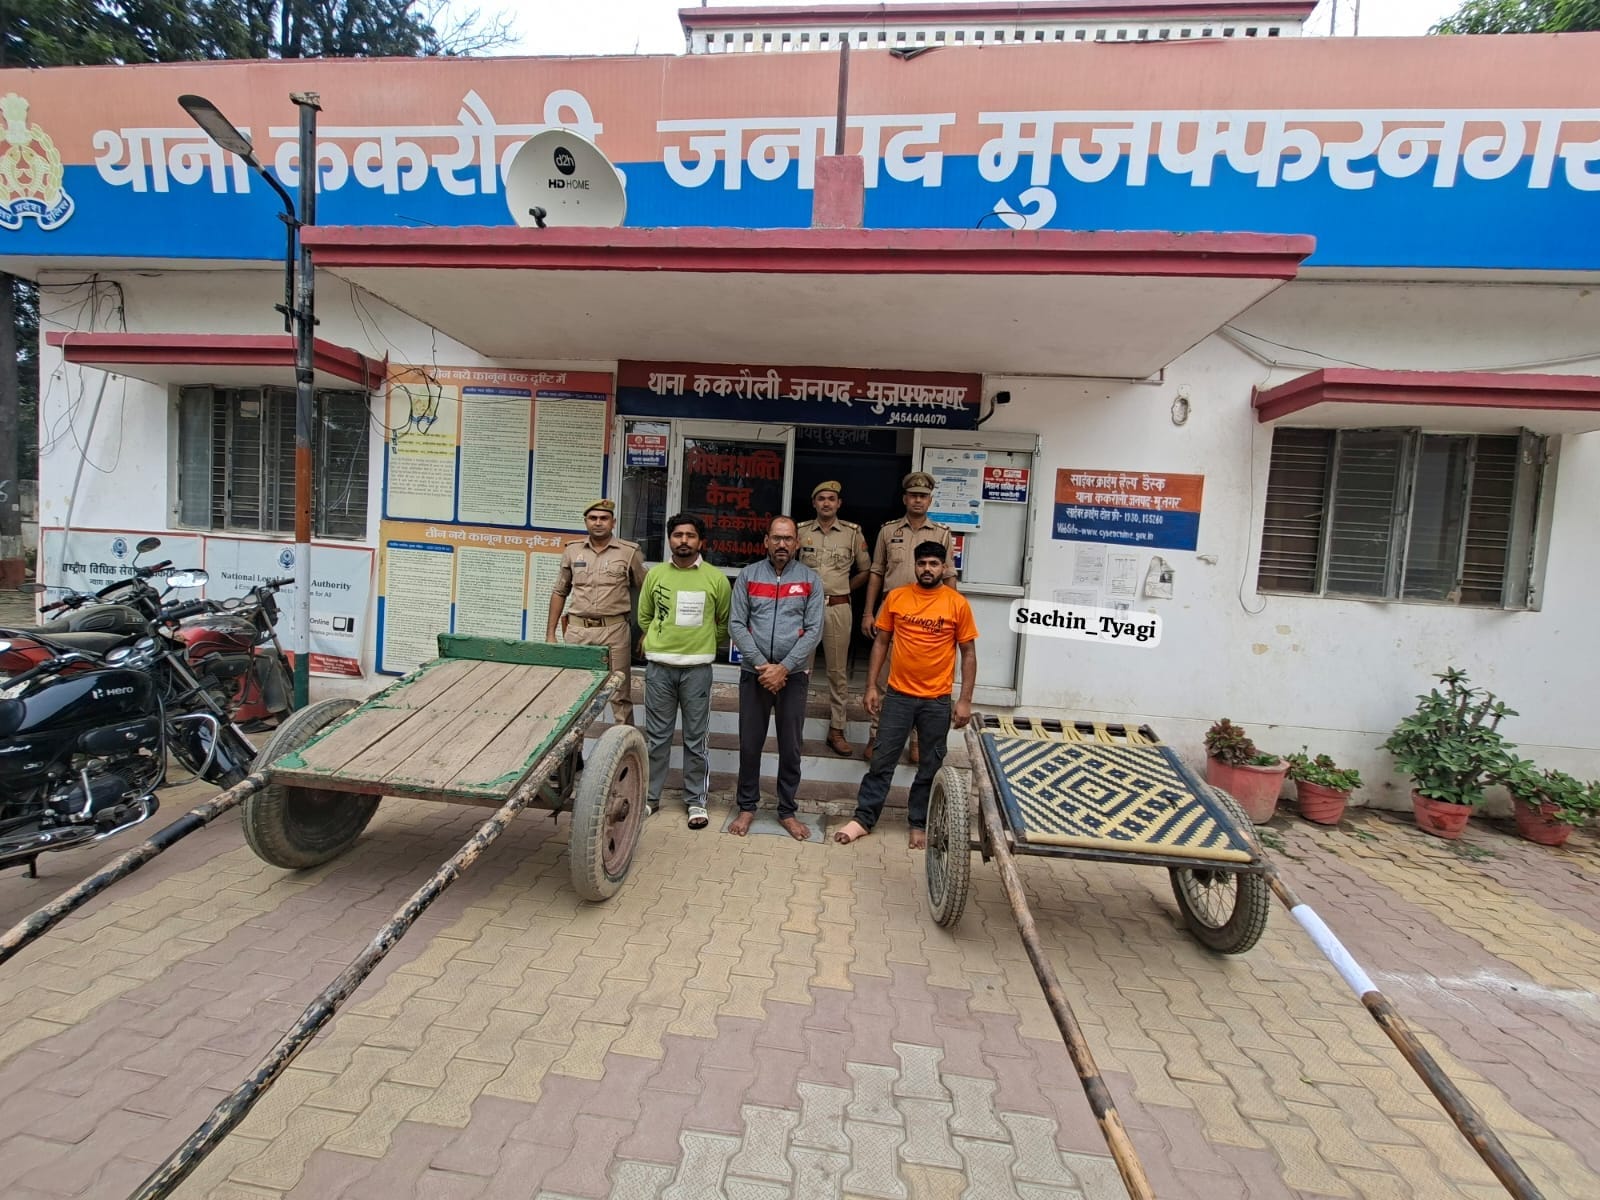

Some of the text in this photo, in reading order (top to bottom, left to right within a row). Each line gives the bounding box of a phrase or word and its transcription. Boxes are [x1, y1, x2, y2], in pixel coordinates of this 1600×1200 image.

[92, 126, 251, 194] थाना
[556, 153, 575, 167] d2h
[566, 179, 590, 190] HOME
[647, 371, 687, 396] थाना
[693, 368, 783, 401] ककरौली
[788, 377, 855, 408] जनपद
[886, 411, 947, 426] 9454404070
[425, 526, 447, 540] तीन
[448, 529, 466, 541] नये
[468, 532, 502, 547] कानून
[503, 534, 524, 546] एक
[220, 571, 256, 582] National
[311, 579, 352, 592] Authority
[106, 686, 134, 696] Hero
